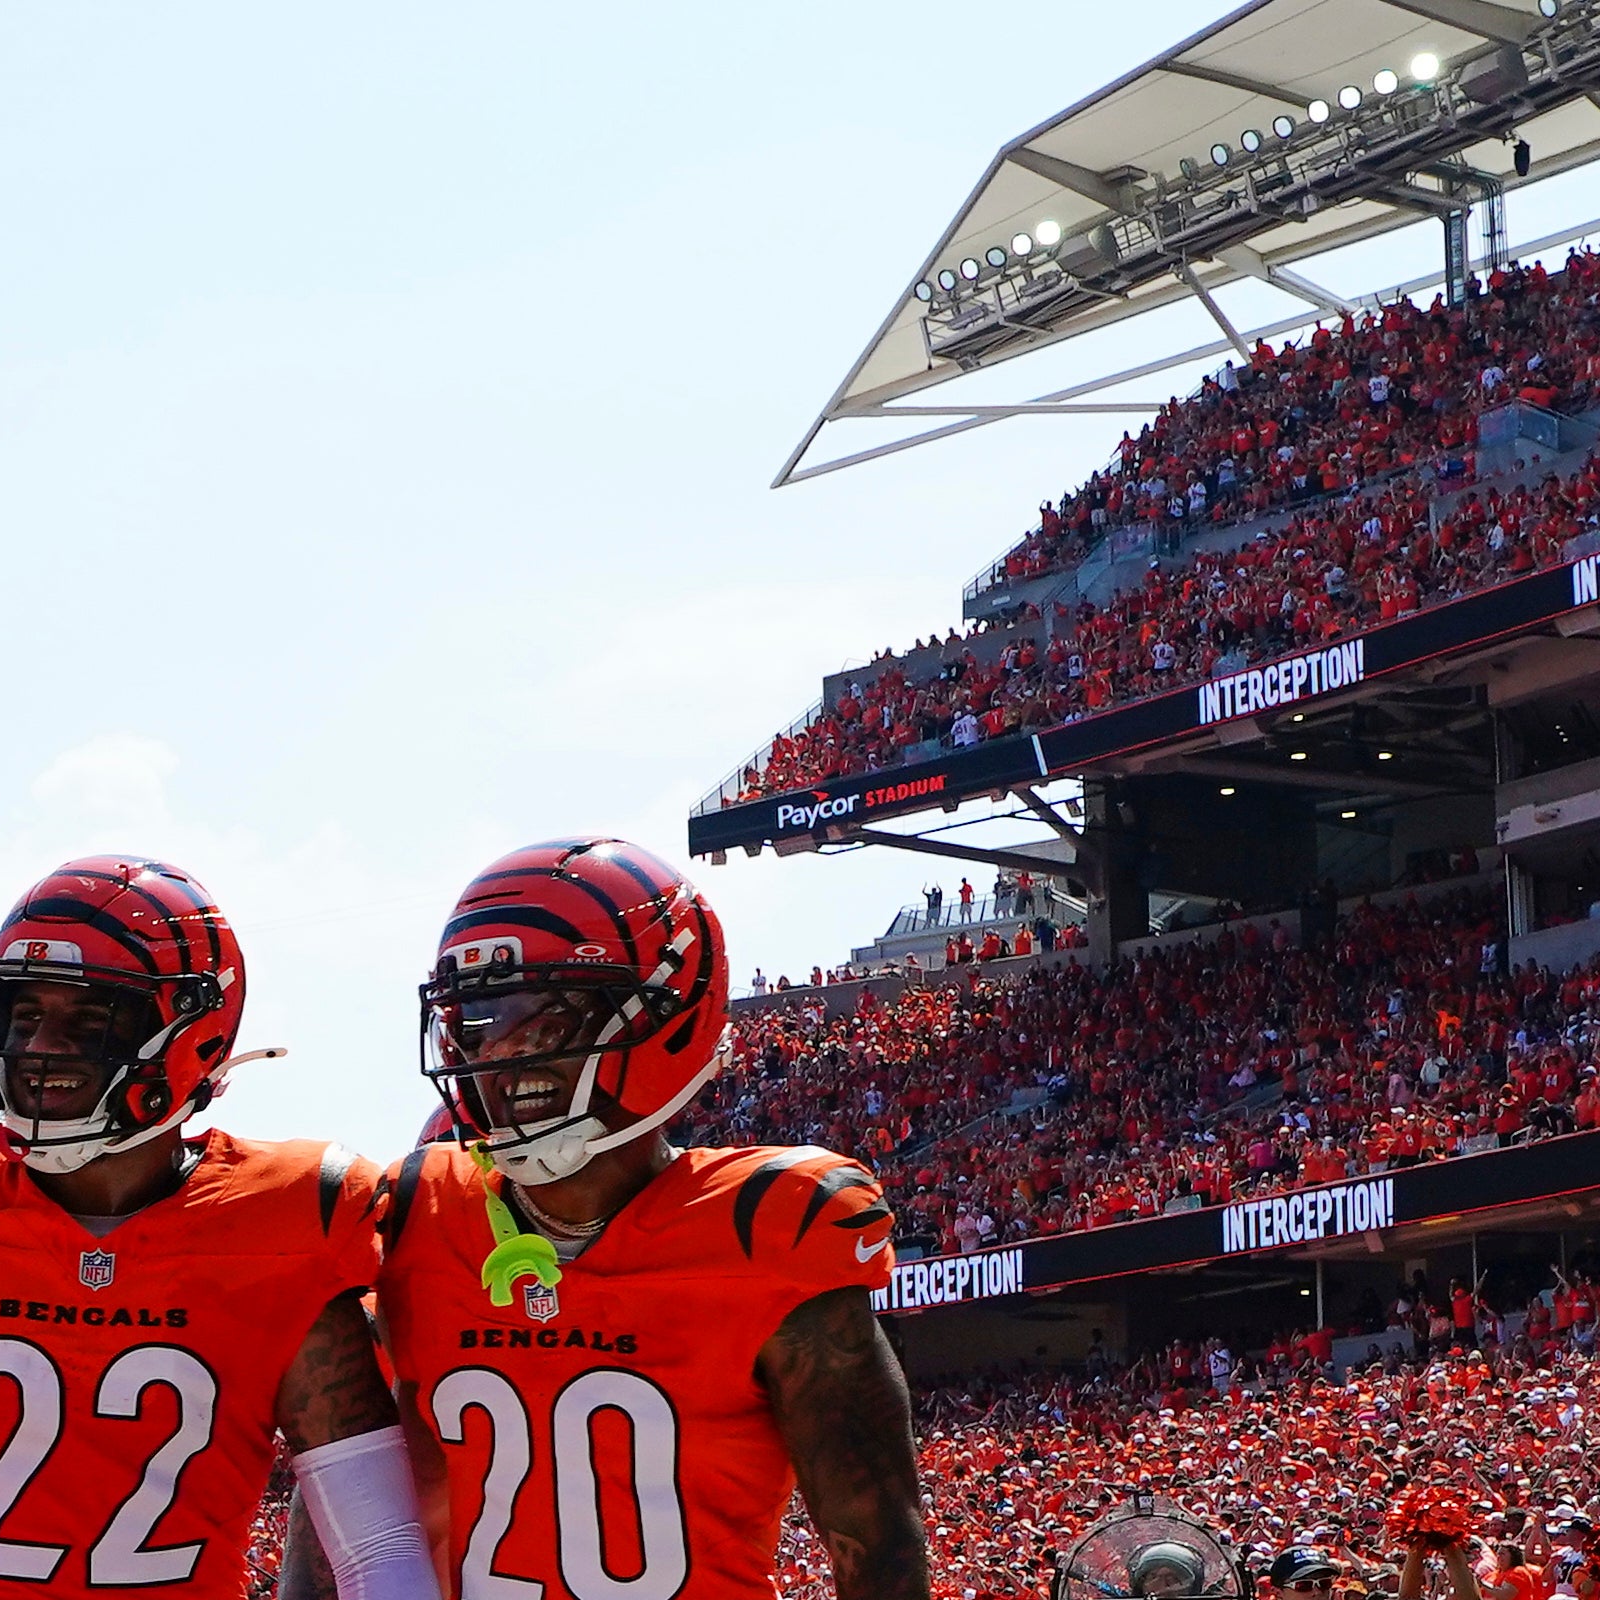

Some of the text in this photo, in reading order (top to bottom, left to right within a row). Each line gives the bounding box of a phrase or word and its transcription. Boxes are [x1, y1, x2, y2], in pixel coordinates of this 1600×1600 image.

[1573, 554, 1600, 606] IN
[1198, 638, 1365, 725] INTERCEPTION!
[777, 774, 947, 829] Paycor STADIUM
[1222, 1178, 1394, 1253] INTERCEPTION!
[85, 1266, 113, 1284] NFL
[530, 1296, 556, 1315] NFL
[459, 1328, 638, 1354] BENGALS
